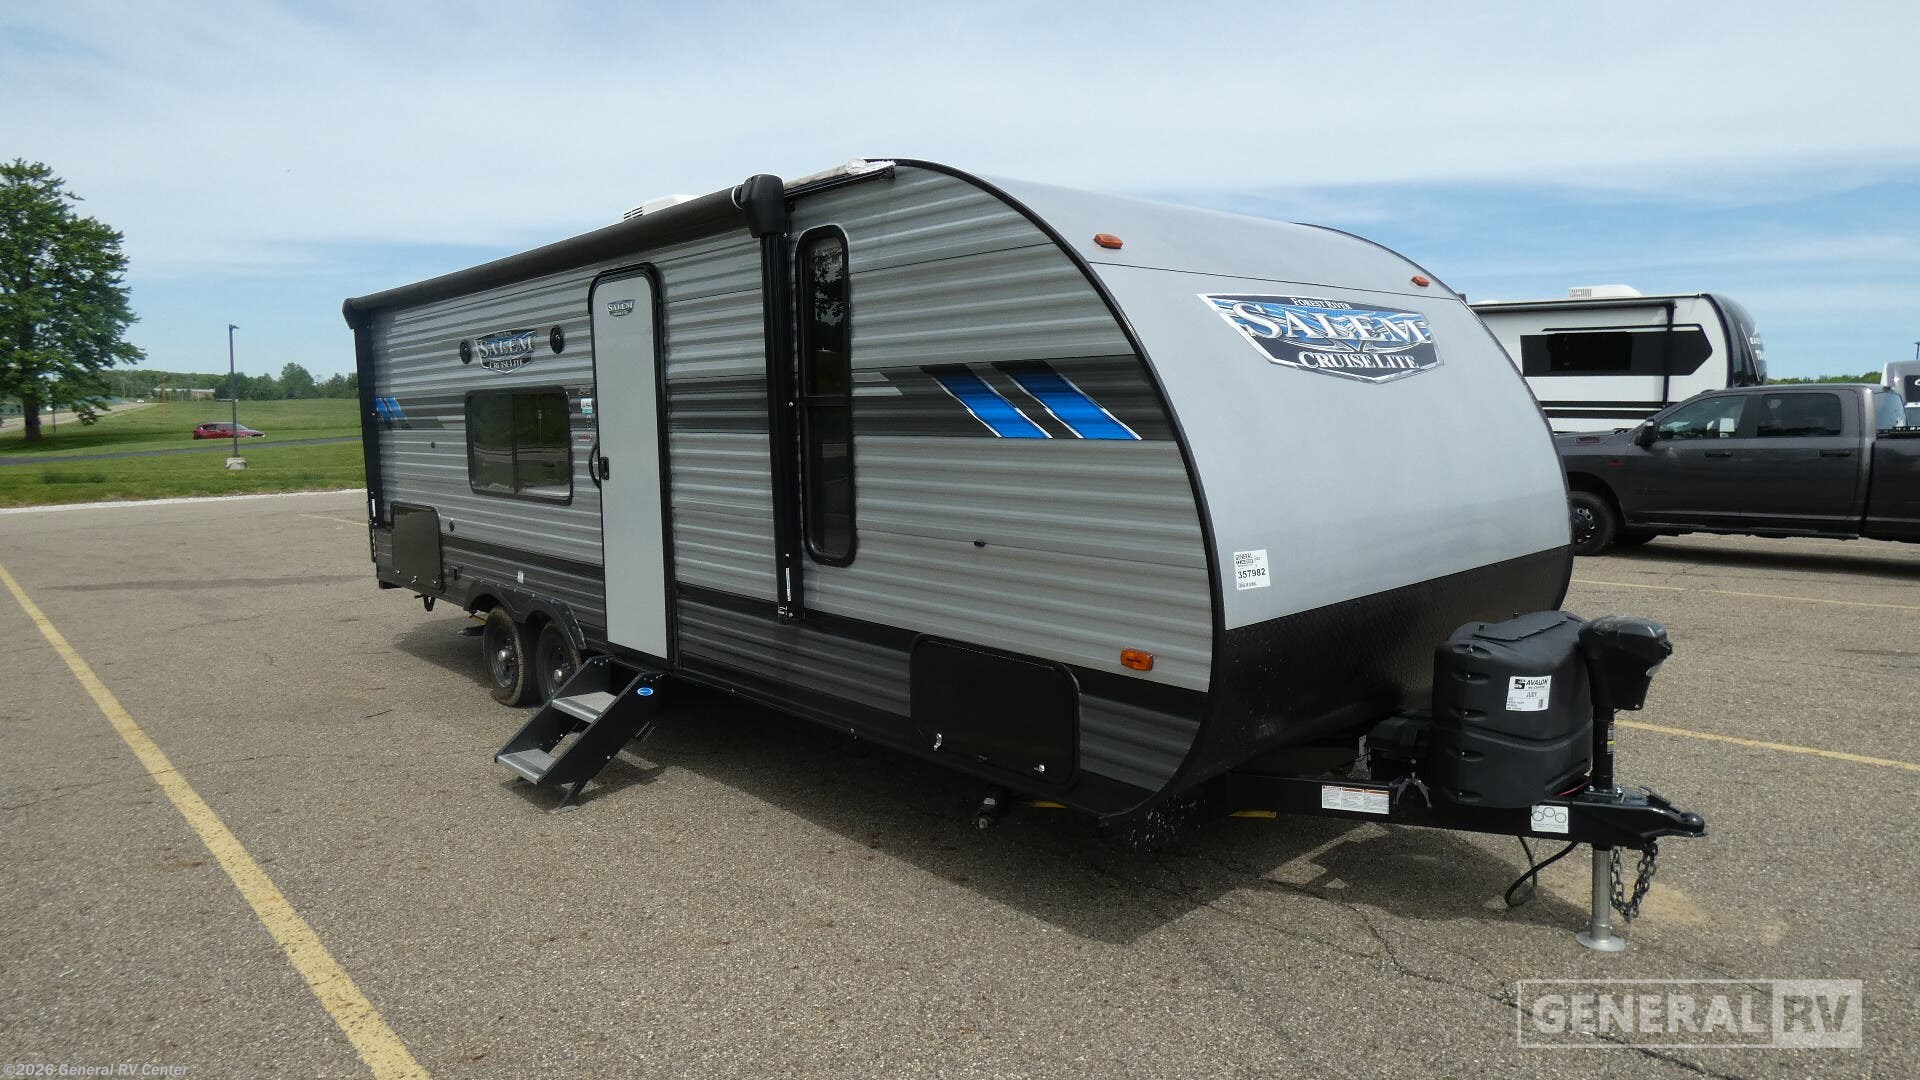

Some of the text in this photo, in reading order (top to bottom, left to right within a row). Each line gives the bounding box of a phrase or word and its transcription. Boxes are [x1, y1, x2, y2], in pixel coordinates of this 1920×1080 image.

[607, 302, 633, 312] SALEM
[1291, 297, 1353, 310] FOREST RIVER
[1232, 302, 1433, 343] SALEM
[480, 336, 533, 357] SALEM
[1237, 567, 1266, 579] 357982
